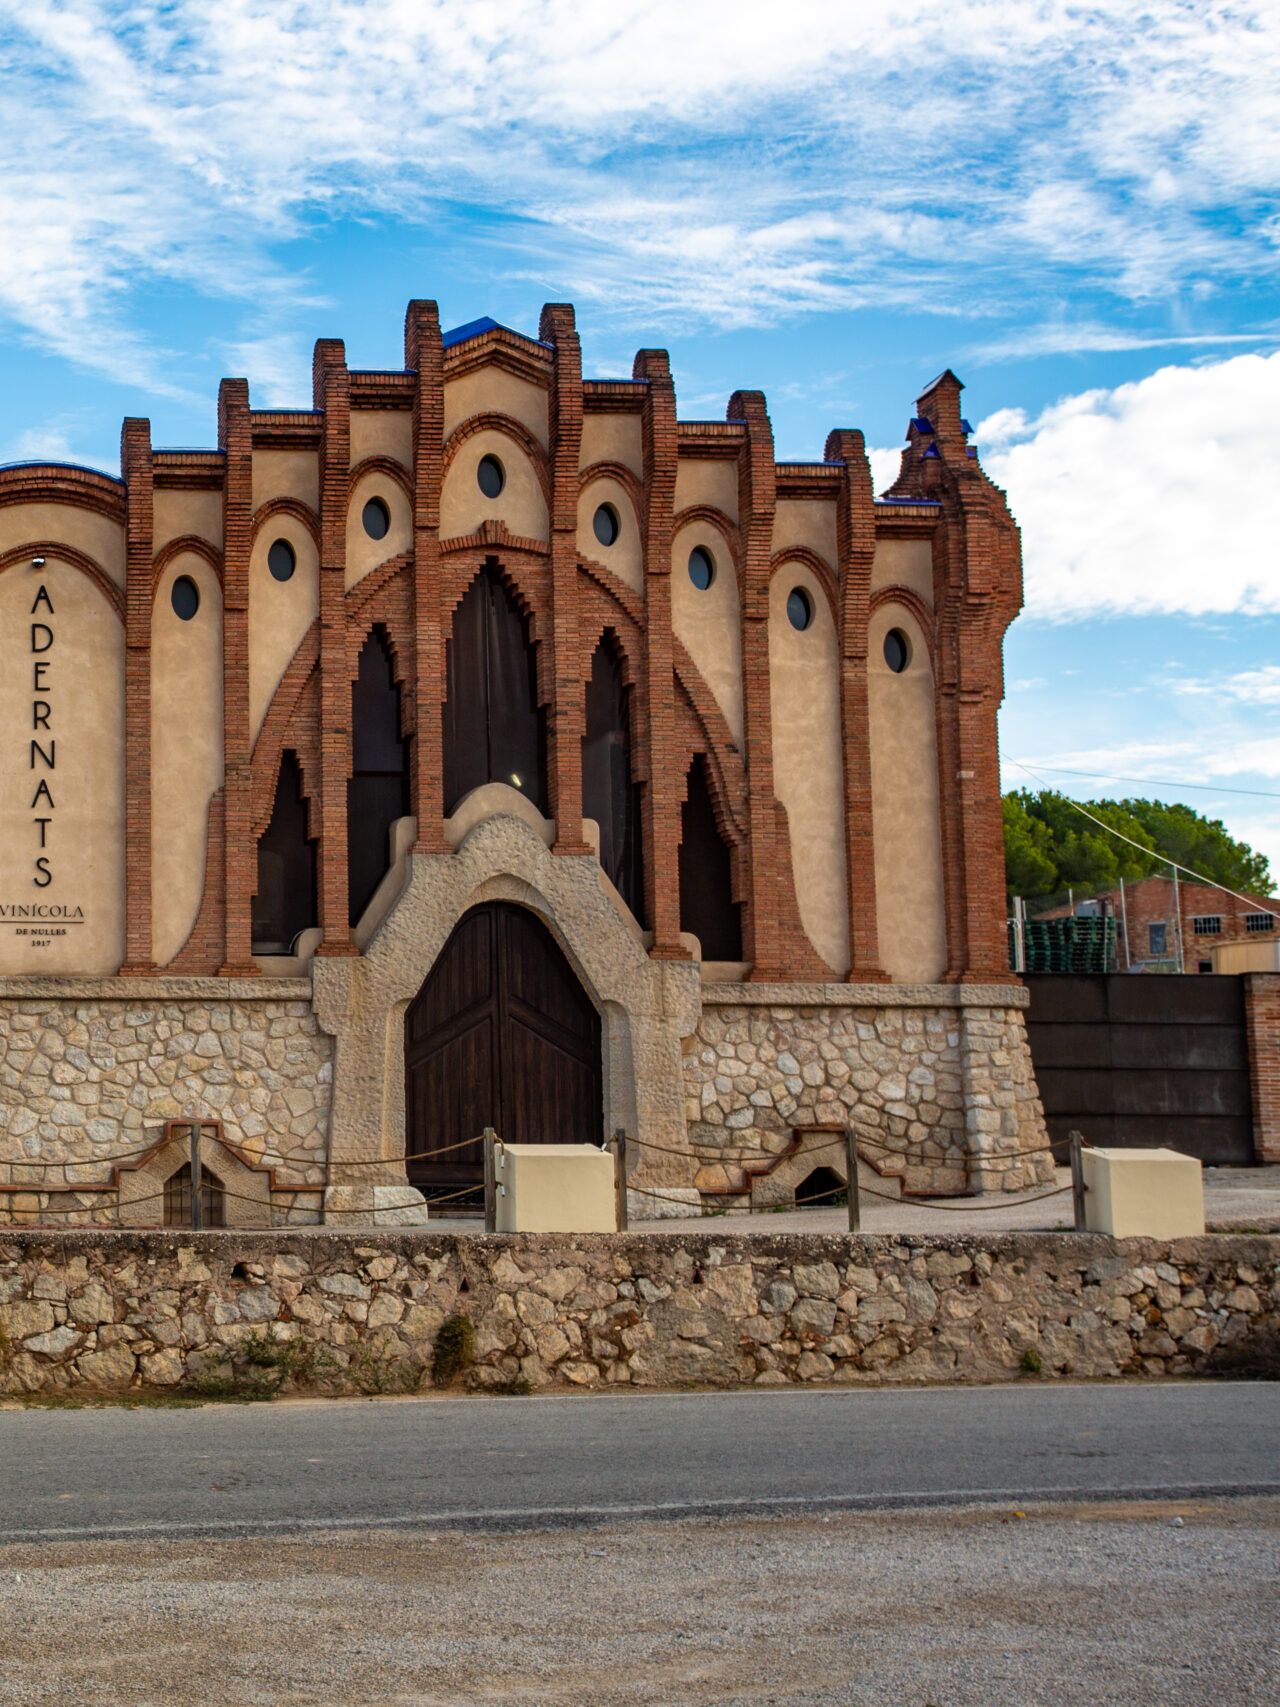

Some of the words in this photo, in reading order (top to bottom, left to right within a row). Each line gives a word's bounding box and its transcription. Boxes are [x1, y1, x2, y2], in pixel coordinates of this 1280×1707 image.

[30, 584, 56, 888] ADERNATS
[15, 928, 28, 936] DE
[30, 928, 67, 936] NULLES
[31, 939, 51, 947] 1917
